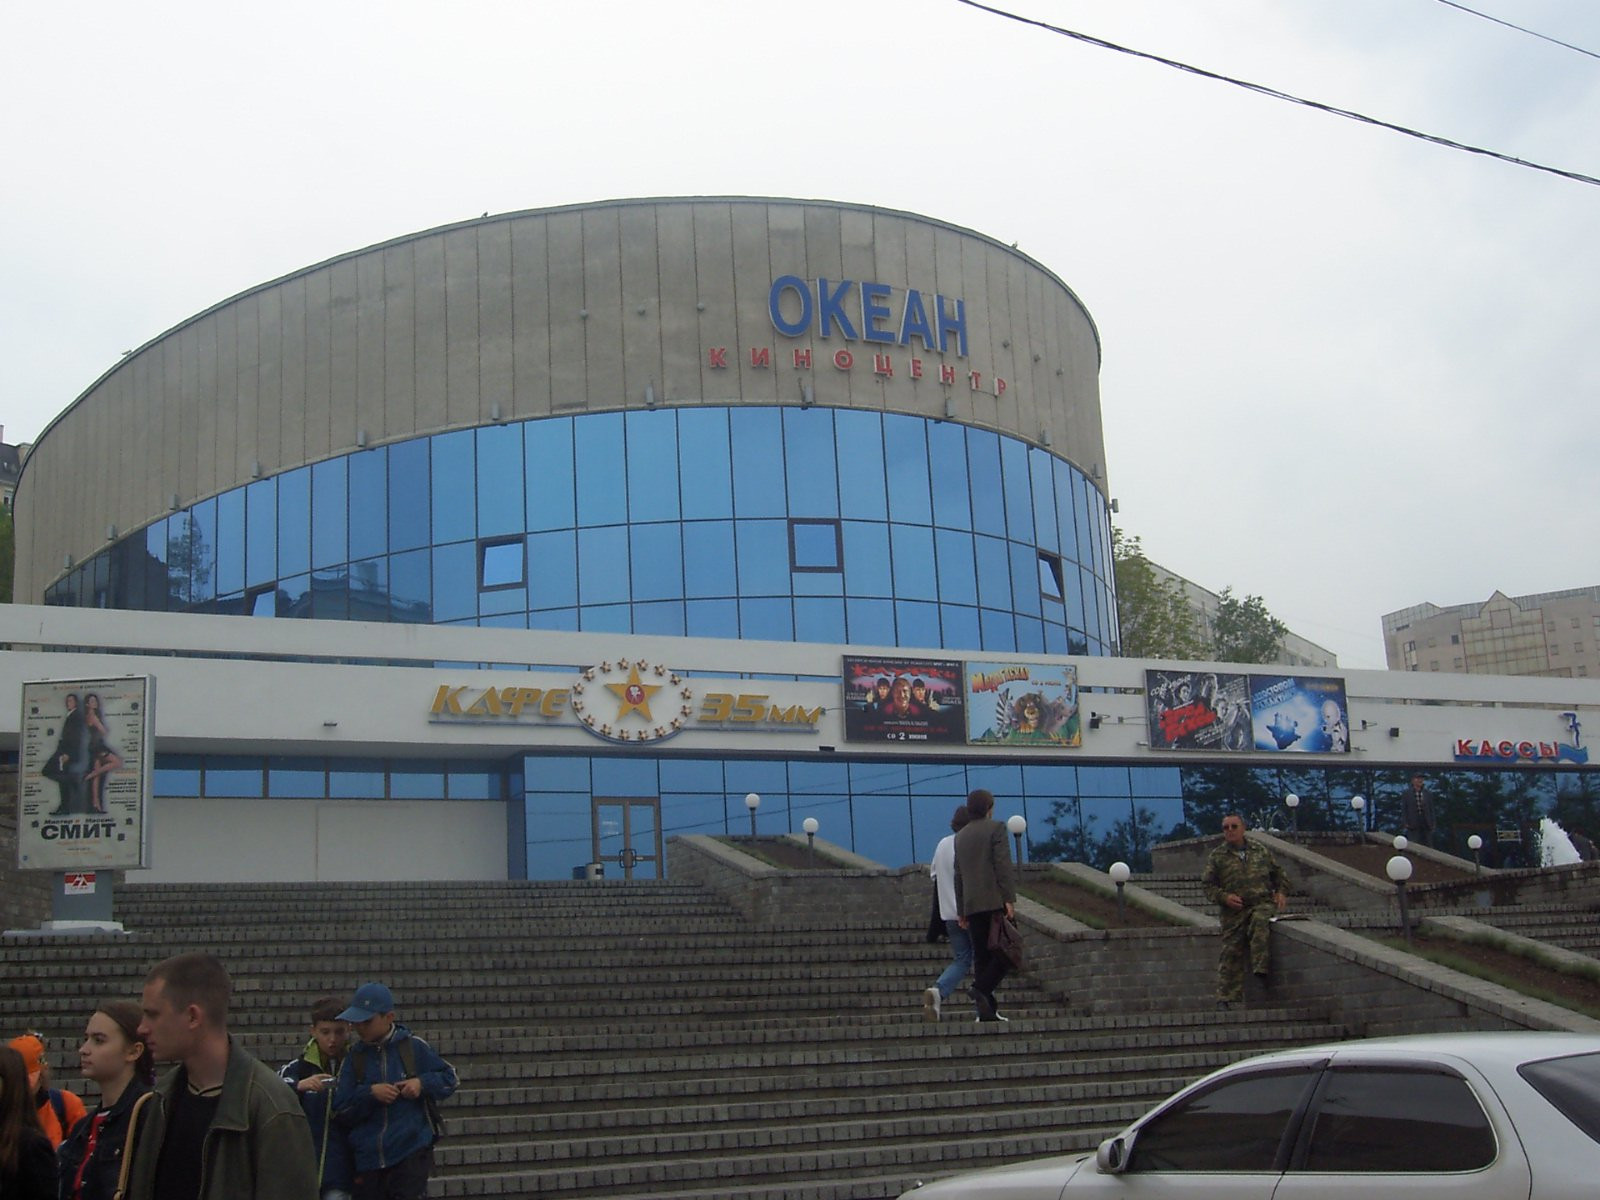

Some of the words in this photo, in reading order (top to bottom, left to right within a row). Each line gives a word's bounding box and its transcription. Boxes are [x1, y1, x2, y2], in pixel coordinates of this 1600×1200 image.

[768, 274, 969, 357] ОКЕАН
[709, 347, 1007, 397] КИНОЦЕНТР
[430, 684, 571, 718] КАФЕ
[898, 731, 906, 741] 2
[1455, 739, 1560, 758] КАССЫ
[41, 823, 117, 840] СМИТ
